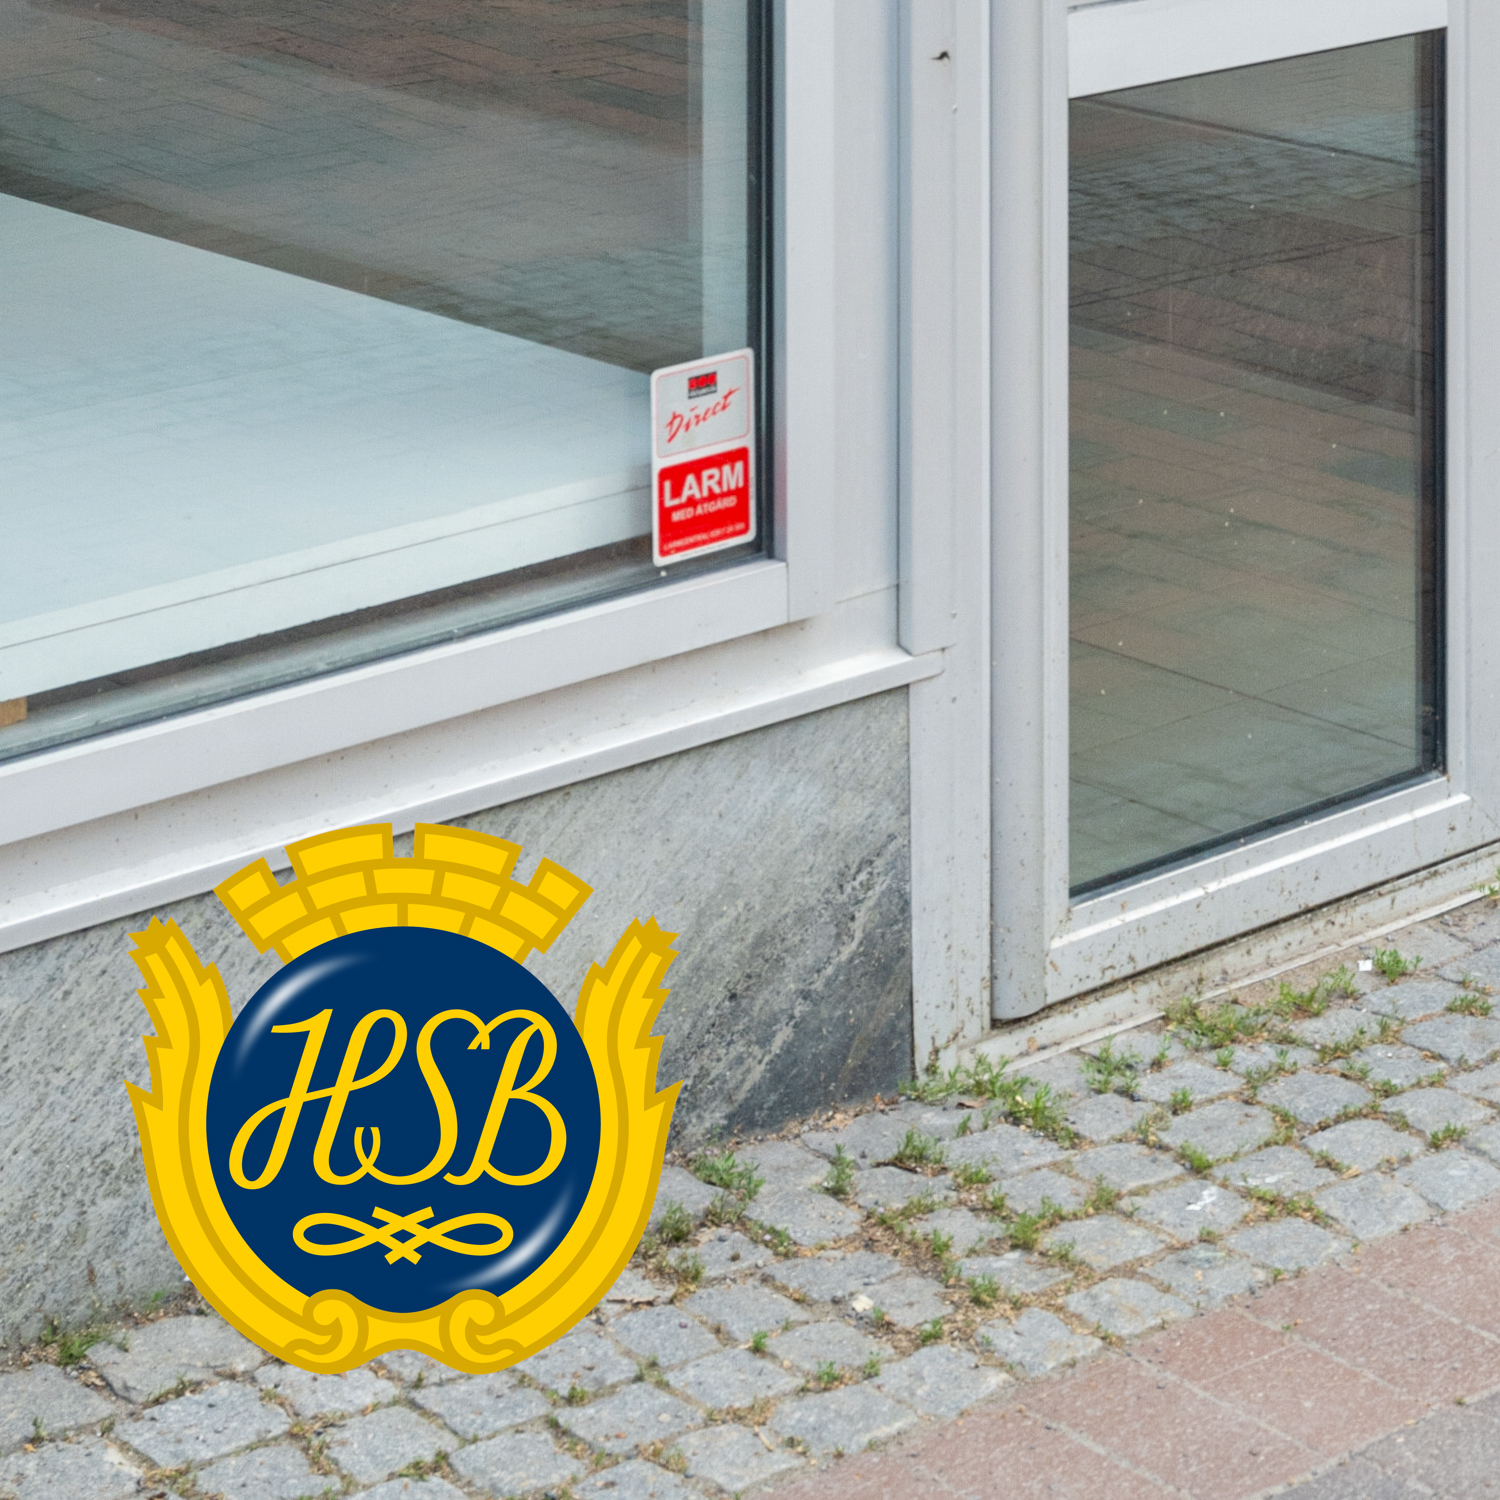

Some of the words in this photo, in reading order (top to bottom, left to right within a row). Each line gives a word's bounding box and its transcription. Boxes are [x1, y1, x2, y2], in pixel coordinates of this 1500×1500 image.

[665, 386, 741, 443] Direct
[663, 460, 744, 508] LARM
[671, 506, 694, 522] MED
